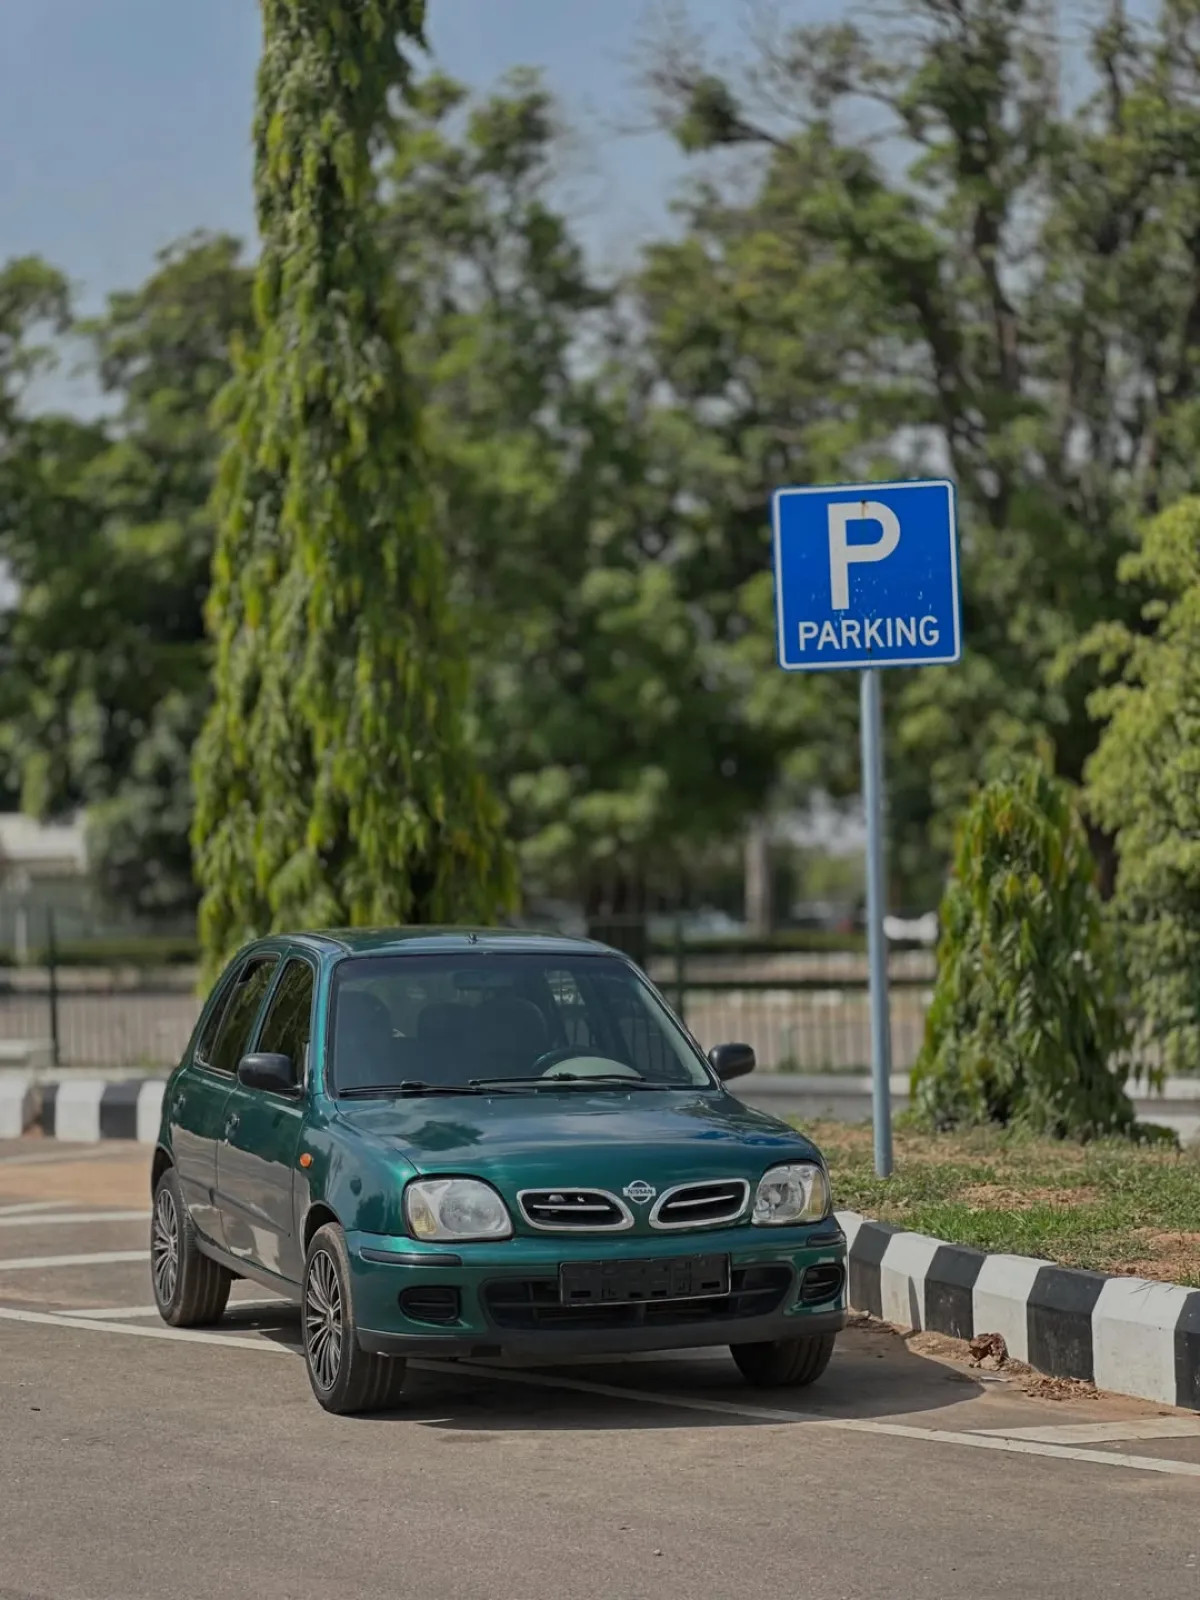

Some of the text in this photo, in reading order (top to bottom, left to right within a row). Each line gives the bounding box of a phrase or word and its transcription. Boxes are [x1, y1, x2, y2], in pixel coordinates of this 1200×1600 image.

[828, 501, 900, 610] P
[799, 615, 940, 651] PARKING
[627, 1188, 653, 1196] NISSAN
